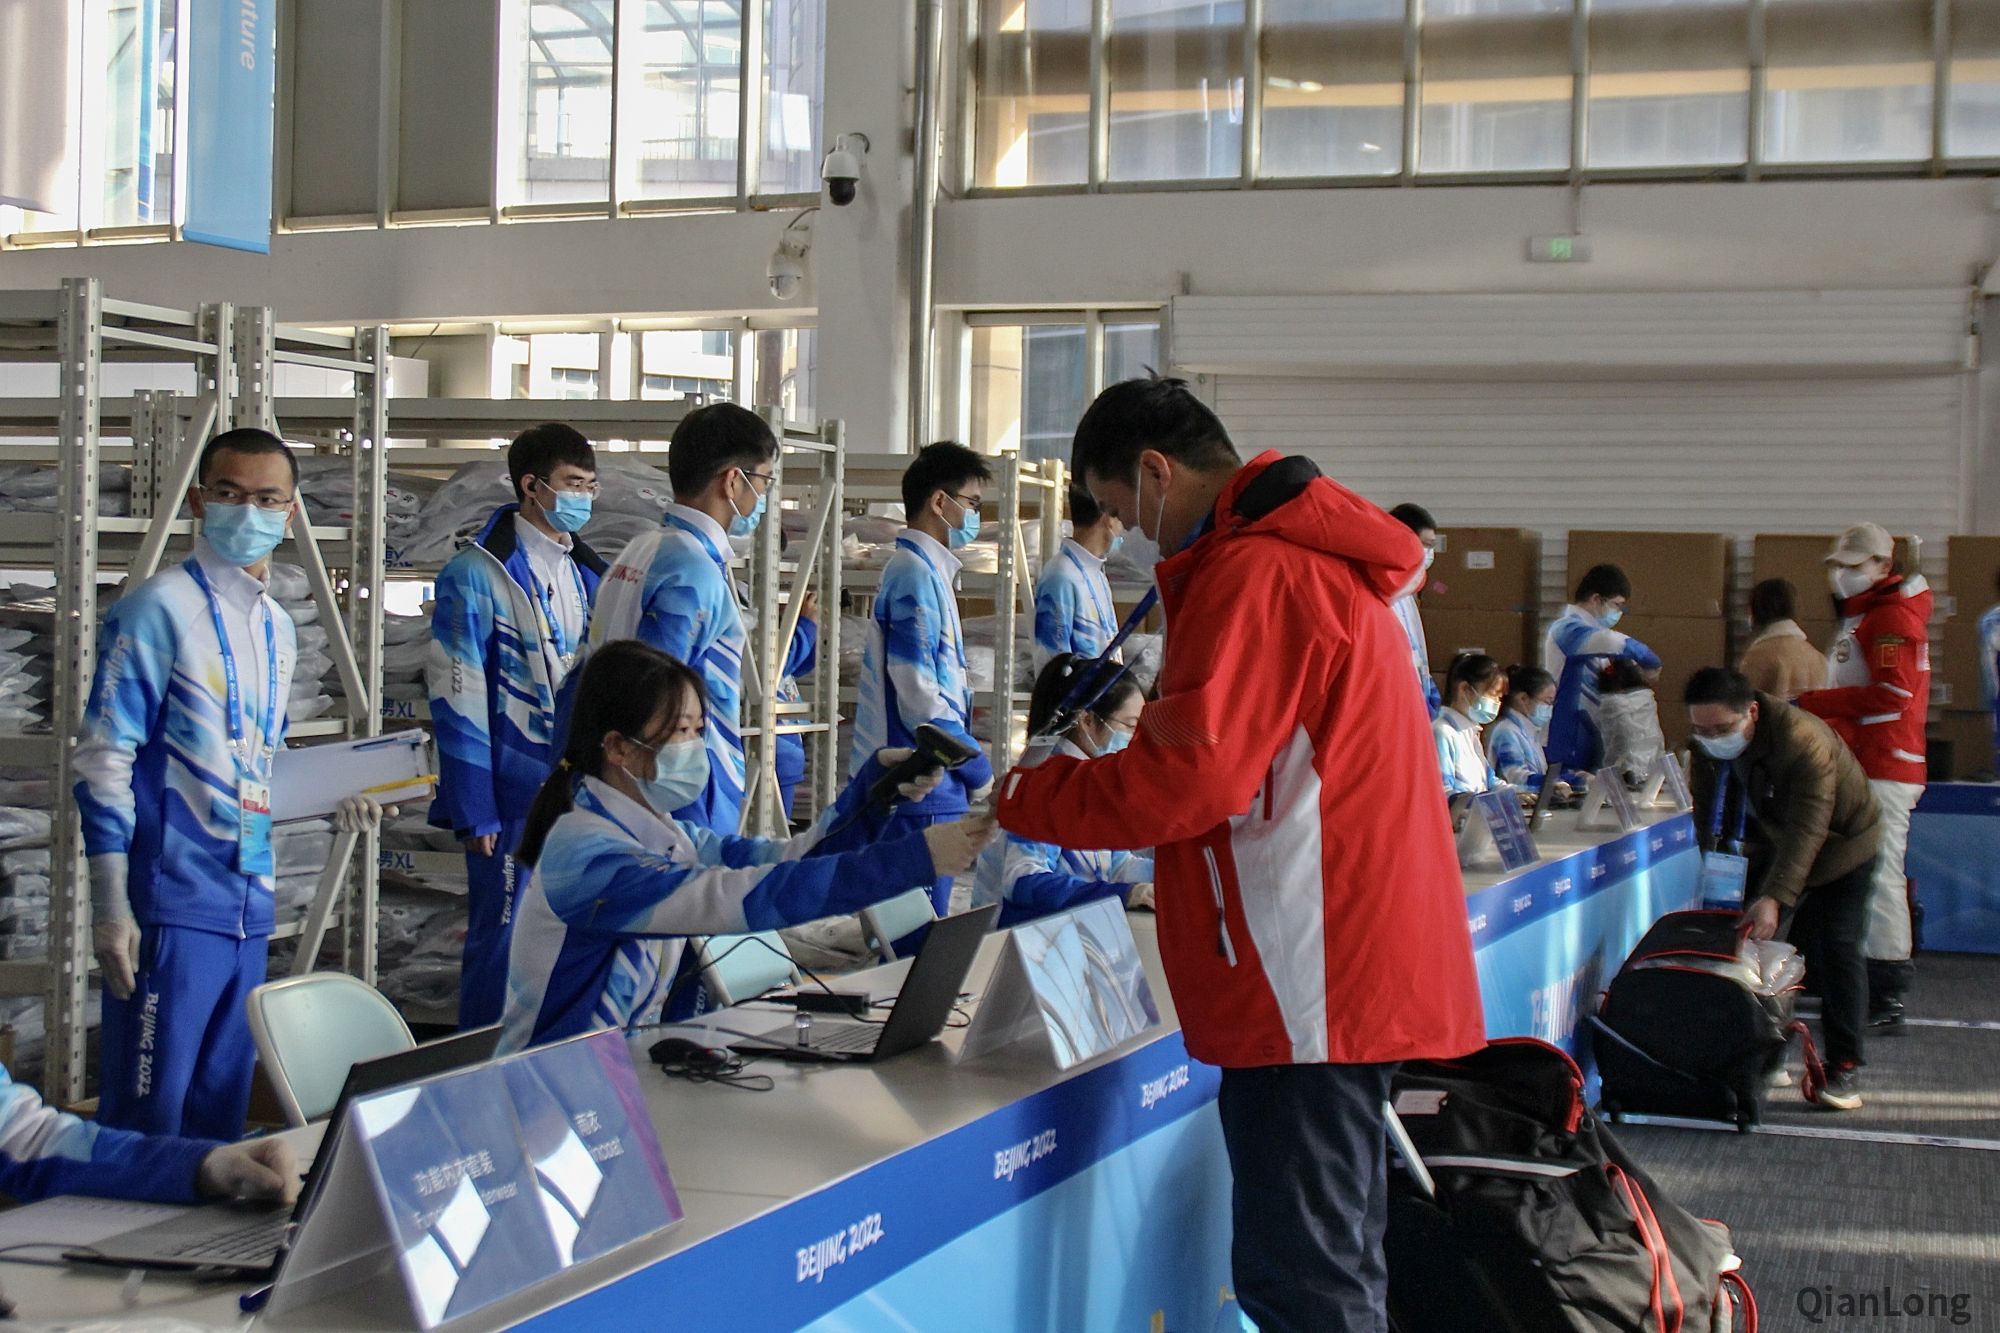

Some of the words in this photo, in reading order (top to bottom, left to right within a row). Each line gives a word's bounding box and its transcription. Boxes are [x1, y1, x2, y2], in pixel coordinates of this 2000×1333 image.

[240, 0, 258, 71] ture
[452, 655, 464, 696] 2022
[140, 993, 159, 1050] BEIJING
[136, 1054, 152, 1098] 2022
[1142, 1075, 1169, 1110] BEIJING
[1169, 1064, 1190, 1093] 2022
[994, 1140, 1031, 1181] BEIJING
[1032, 1129, 1057, 1162] 2022
[796, 1230, 846, 1283] BEIJING
[848, 1213, 885, 1255] 2022
